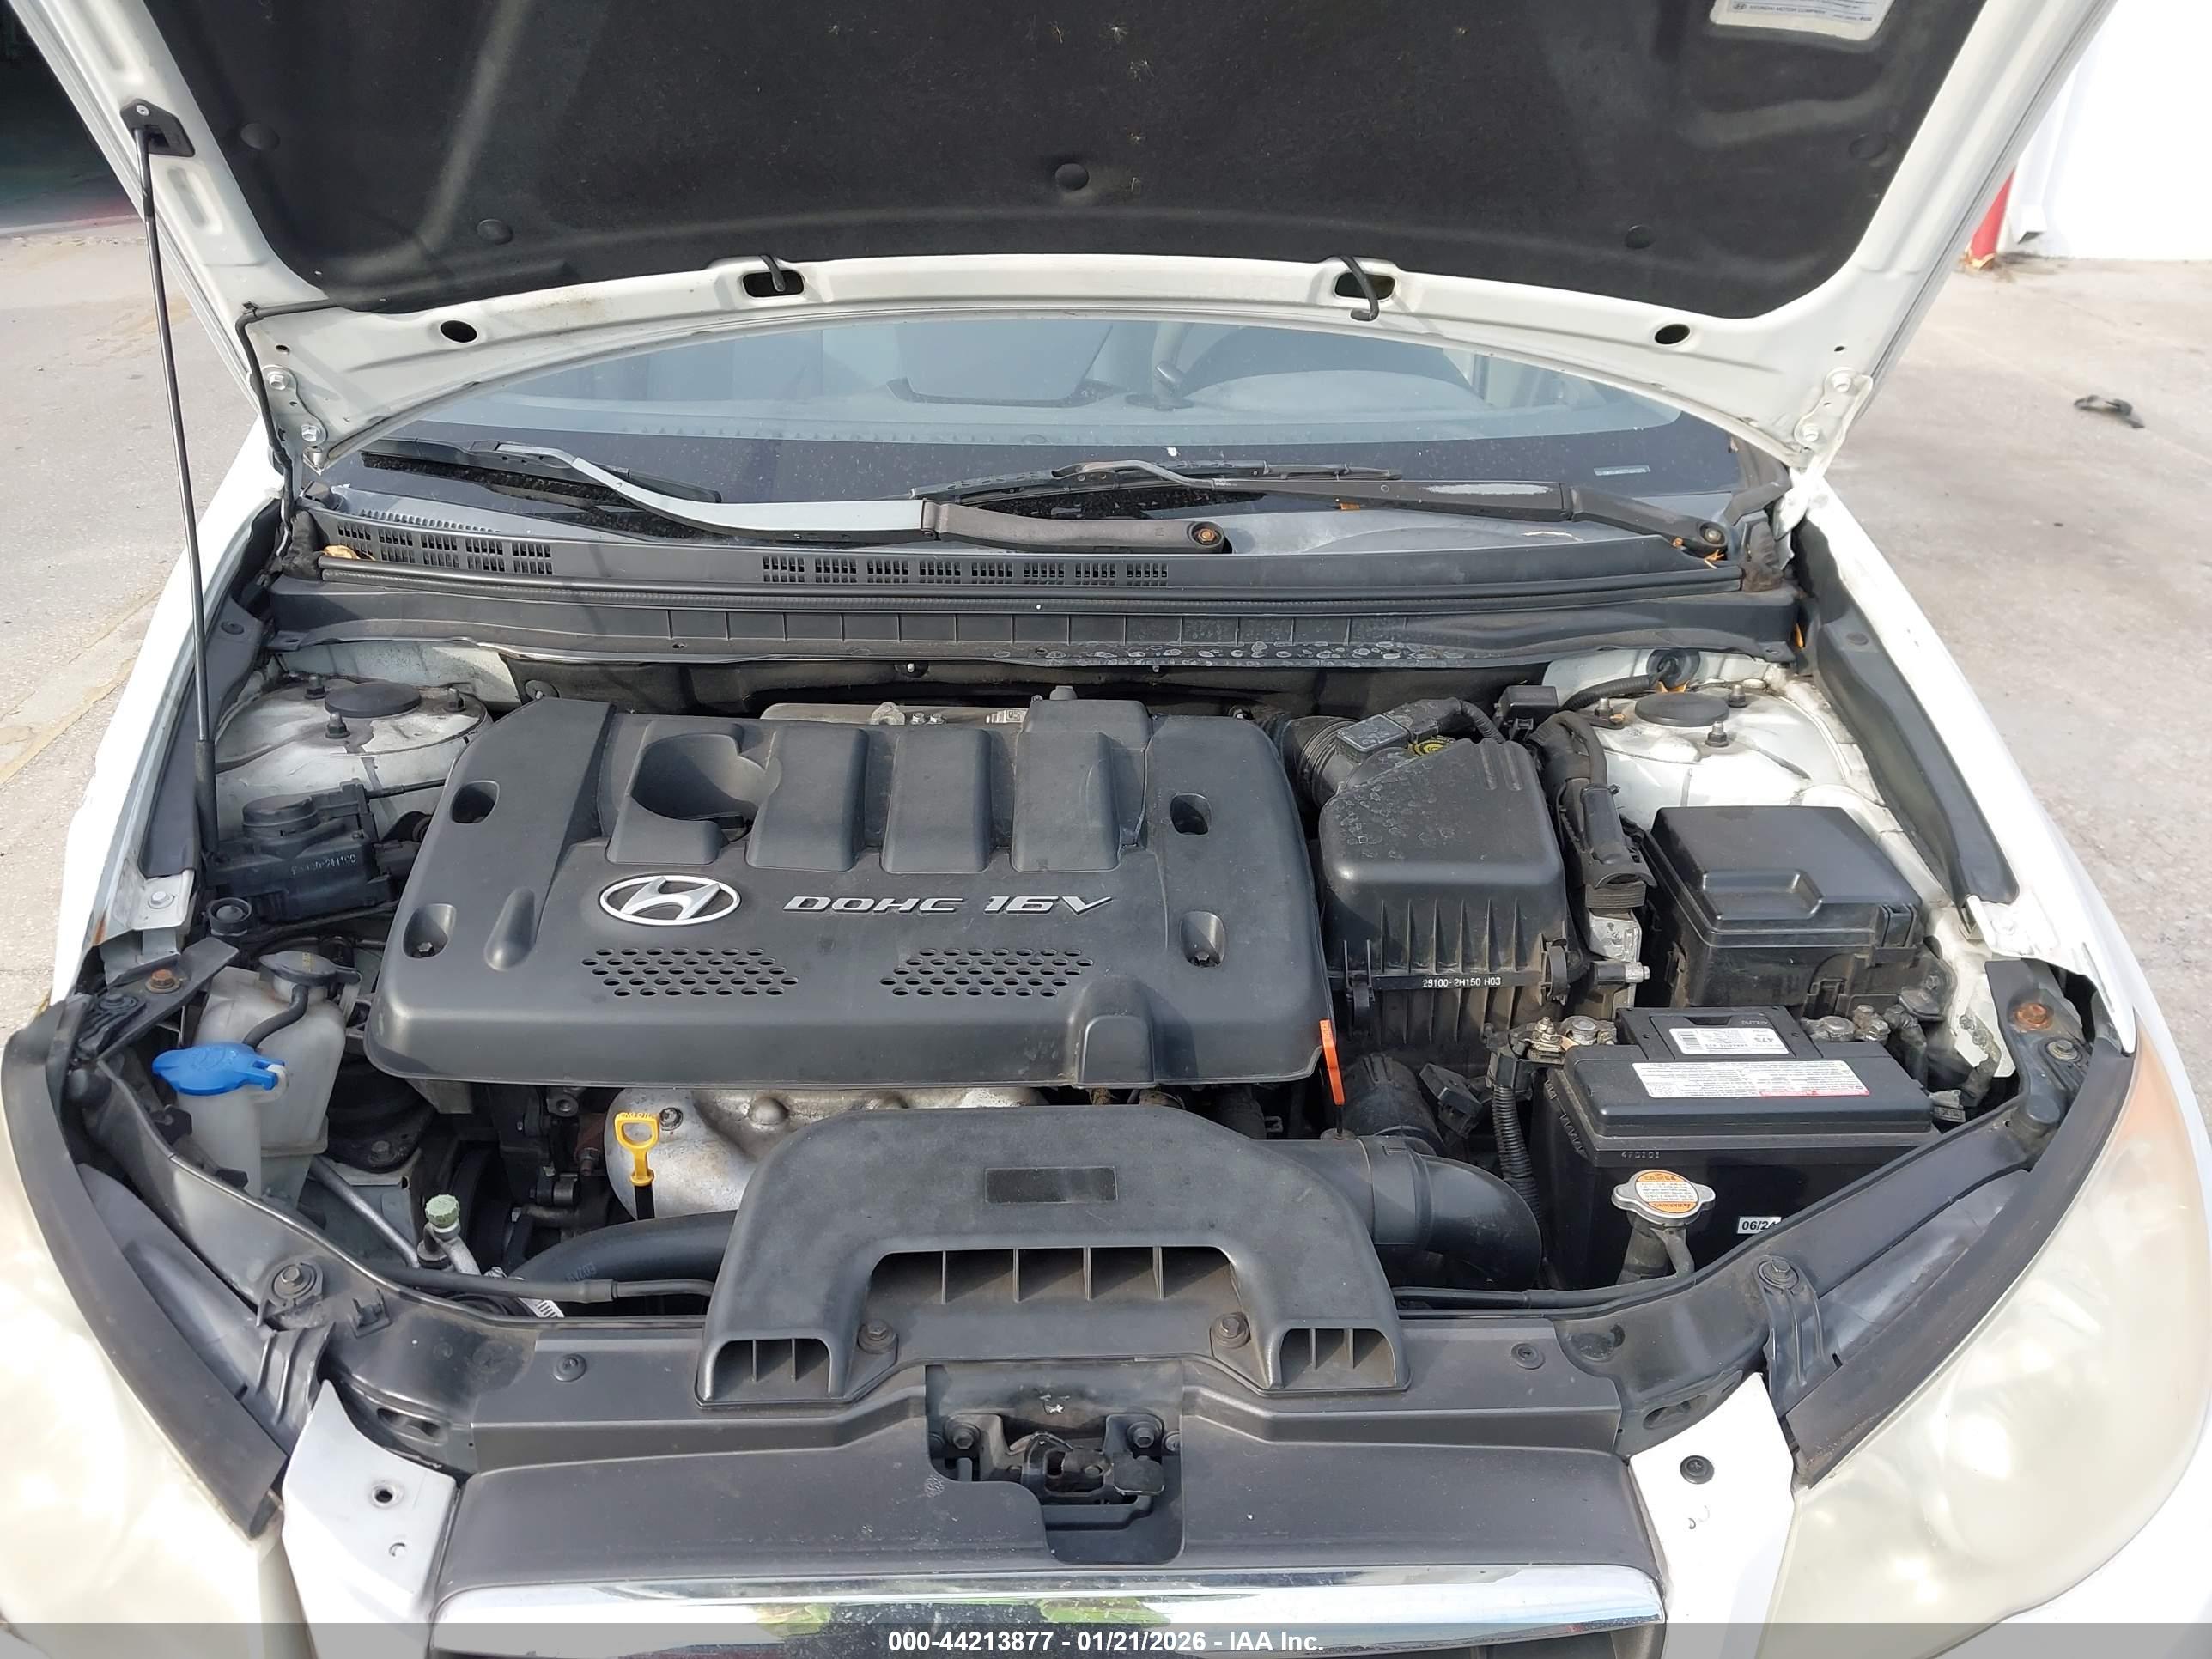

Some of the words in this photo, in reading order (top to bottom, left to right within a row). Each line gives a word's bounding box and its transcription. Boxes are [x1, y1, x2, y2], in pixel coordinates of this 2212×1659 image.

[782, 896, 963, 913] DOHC
[983, 896, 1114, 915] 16V
[1484, 976, 1502, 986] H03
